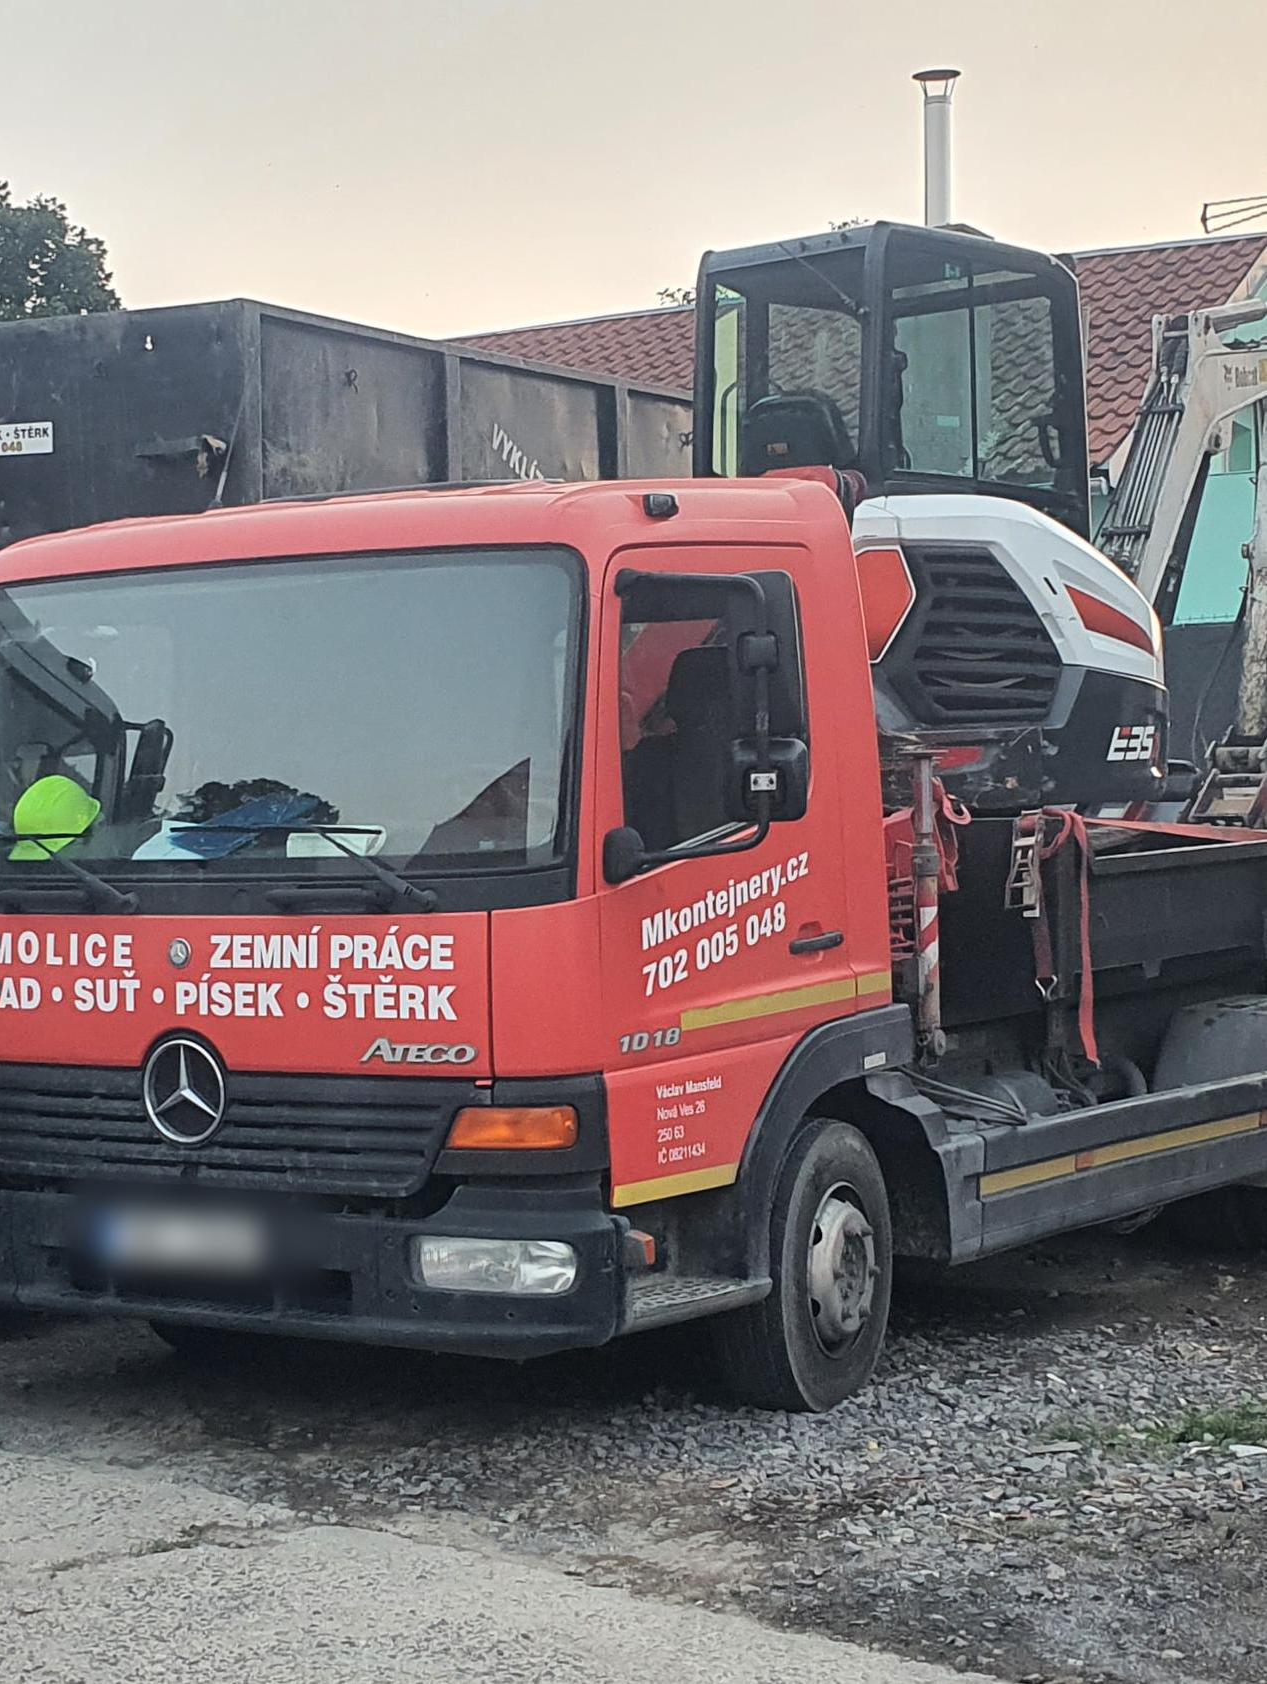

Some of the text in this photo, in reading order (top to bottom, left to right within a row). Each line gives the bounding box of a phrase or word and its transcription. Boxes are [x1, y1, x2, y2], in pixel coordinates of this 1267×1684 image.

[13, 426, 50, 440] ŠTĚRK
[492, 423, 544, 479] VYKLÍ
[1106, 726, 1155, 761] E35
[641, 851, 810, 951] Mkontejnery.cz
[210, 926, 320, 970] ZEMNÍ
[330, 925, 455, 971] PRÁCE
[642, 902, 787, 997] 702 005 048
[74, 970, 141, 1012] SUŤ
[175, 973, 284, 1017] PÍSEK
[323, 974, 458, 1021] ŠTĚRK
[619, 1027, 683, 1053] 1018
[656, 1083, 684, 1099] Václav
[657, 1125, 685, 1142] 250 63
